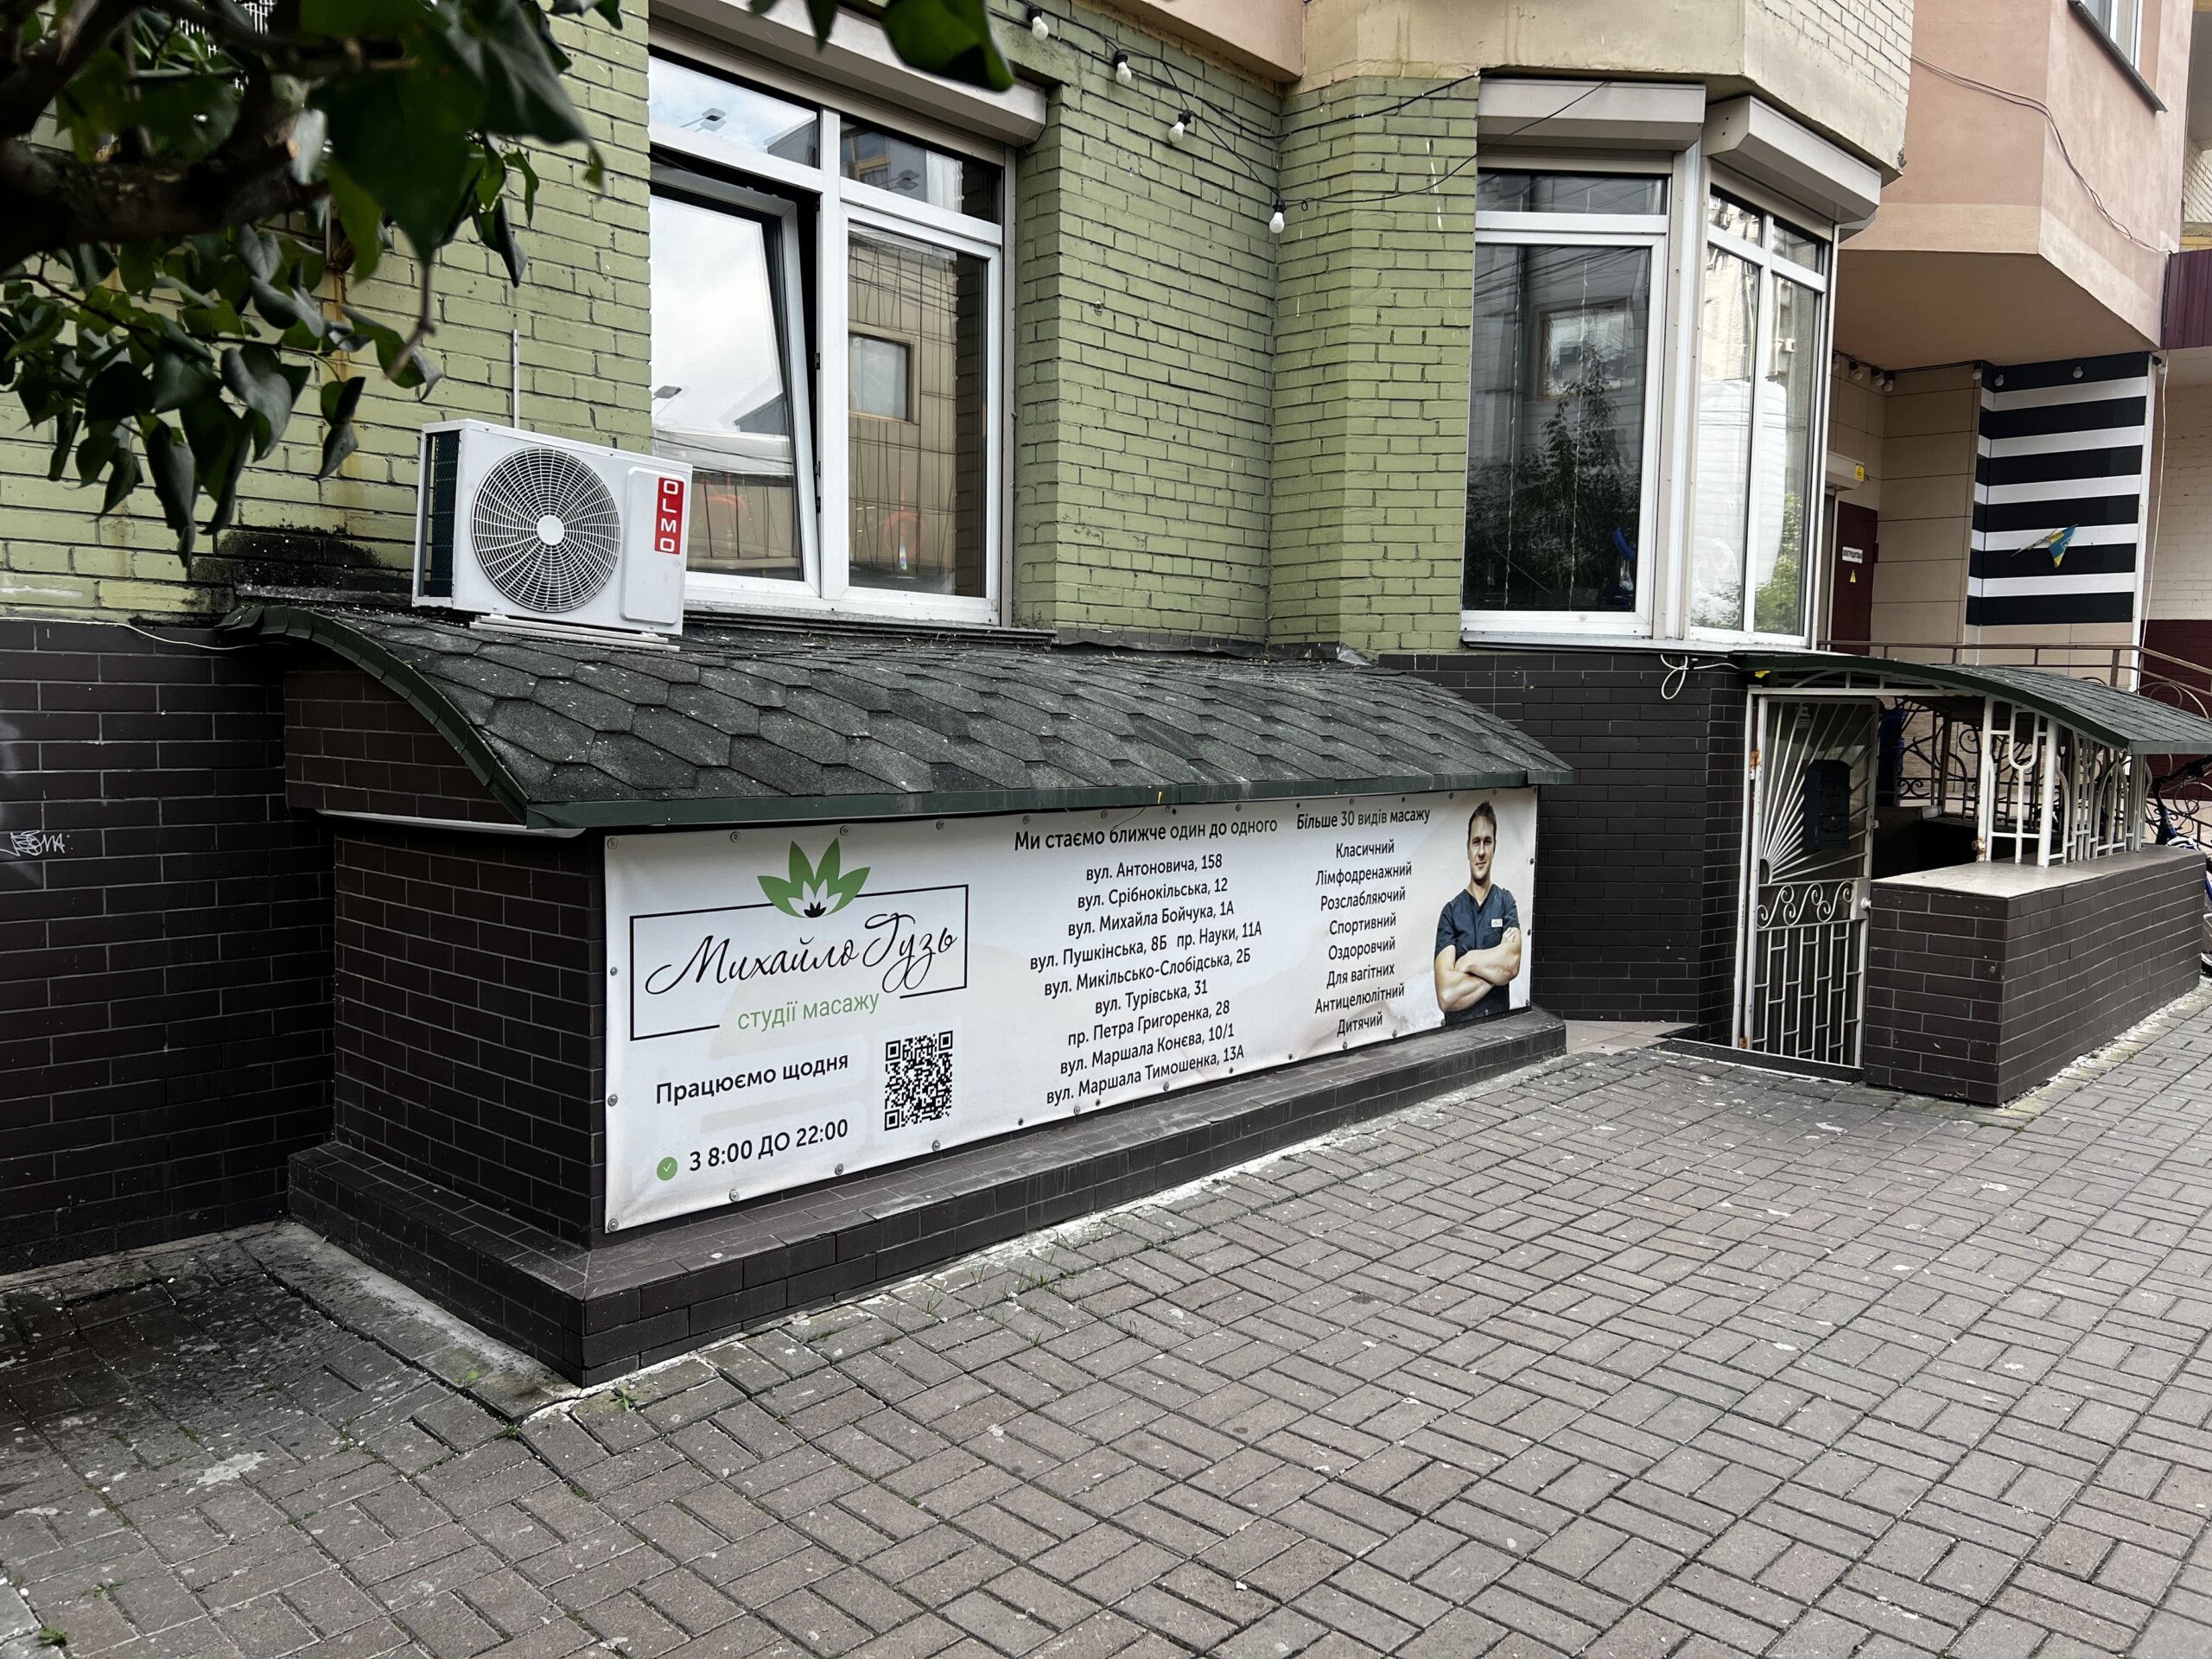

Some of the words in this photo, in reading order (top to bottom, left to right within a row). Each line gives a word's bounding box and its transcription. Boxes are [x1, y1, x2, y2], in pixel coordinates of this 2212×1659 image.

[658, 480, 679, 553] OLMO
[1014, 831, 1040, 851] Ми
[1046, 831, 1104, 849] стаємо
[1109, 826, 1166, 843] ближче
[1170, 824, 1205, 841] один
[1209, 823, 1227, 839] до
[1230, 820, 1277, 836] одного
[1297, 813, 1338, 830] Більше
[1341, 810, 1354, 826] 30
[1357, 809, 1387, 827] видів
[1390, 810, 1430, 824] масажу
[1336, 838, 1395, 858] Класичний
[1086, 868, 1112, 885] вул.
[1116, 860, 1198, 878] Антоновича,
[1201, 853, 1222, 869] 158
[1316, 862, 1412, 887] Лімфодренажний
[1077, 894, 1104, 912] вул.
[1109, 883, 1211, 907] Срібнокільська,
[1214, 877, 1228, 893] 12
[1320, 886, 1406, 912] Розслабляючий
[1068, 921, 1095, 940] вул.
[1099, 911, 1158, 932] Михайла
[1161, 906, 1217, 924] Бойчука,
[1220, 900, 1234, 916] 1А
[1329, 912, 1396, 936] Спортивний
[645, 935, 860, 995] Михайло
[862, 912, 958, 994] Гузь
[1030, 955, 1058, 973] вул.
[1063, 942, 1147, 968] Пушкінська,
[1151, 934, 1167, 951] 8Б
[1177, 934, 1195, 950] пр.
[1199, 927, 1238, 946] Науки,
[1242, 920, 1262, 938] 11А
[1328, 936, 1395, 961] Оздоровчий
[1045, 981, 1072, 1000] вул.
[1077, 953, 1233, 990] Микільсько-Слобідська,
[1236, 947, 1250, 964] 2Б
[1326, 970, 1348, 989] Для
[1351, 963, 1395, 982] вагітних
[738, 1001, 798, 1032] студії
[804, 993, 879, 1020] масажу
[1095, 999, 1122, 1017] вул.
[1125, 985, 1191, 1010] Турівська,
[1194, 979, 1208, 995] 31
[1315, 983, 1405, 1014] Антицелюлітний
[1068, 1032, 1089, 1048] пр.
[1093, 1021, 1134, 1040] Петра
[1138, 1007, 1212, 1033] Григоренка,
[1216, 1000, 1230, 1016] 28
[1337, 1011, 1382, 1038] Дитячий
[1060, 1058, 1087, 1077] вул.
[1091, 1043, 1154, 1068] Маршала
[1157, 1033, 1205, 1052] Конєва,
[1209, 1023, 1234, 1042] 10/1
[657, 1069, 776, 1106] Працюємо
[783, 1055, 848, 1080] щодня
[1046, 1088, 1074, 1107] вул.
[1078, 1071, 1141, 1097] Маршала
[1144, 1054, 1220, 1080] Тимошенка,
[1223, 1045, 1244, 1063] 13А
[708, 1140, 753, 1167] 8:00
[758, 1132, 790, 1160] ДО
[796, 1119, 848, 1147] 22:00
